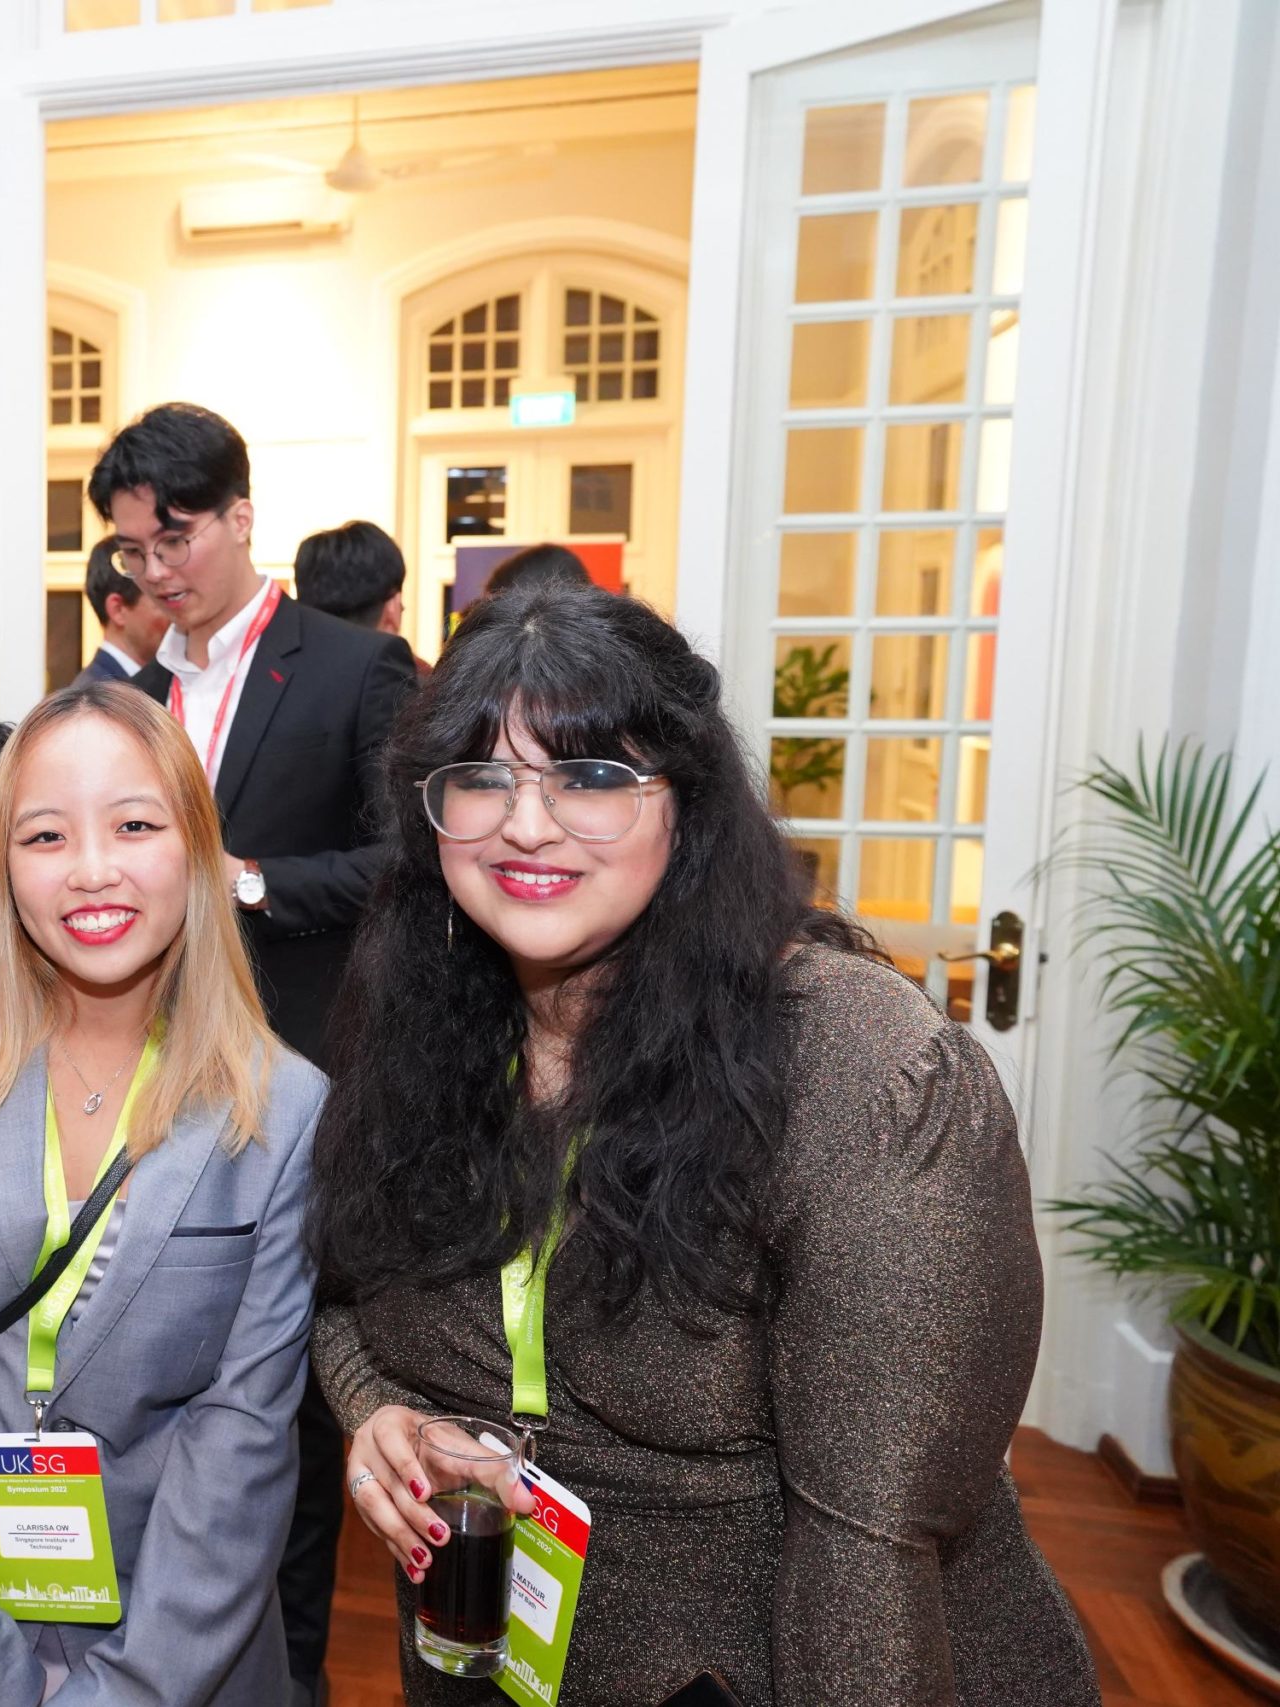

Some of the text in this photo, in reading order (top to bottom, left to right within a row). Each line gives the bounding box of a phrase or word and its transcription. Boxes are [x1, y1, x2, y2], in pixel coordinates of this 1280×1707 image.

[0, 1454, 66, 1474] UKSG
[7, 1486, 49, 1495] Symposium
[531, 1494, 560, 1534] SG
[516, 1572, 546, 1602] MATHUR
